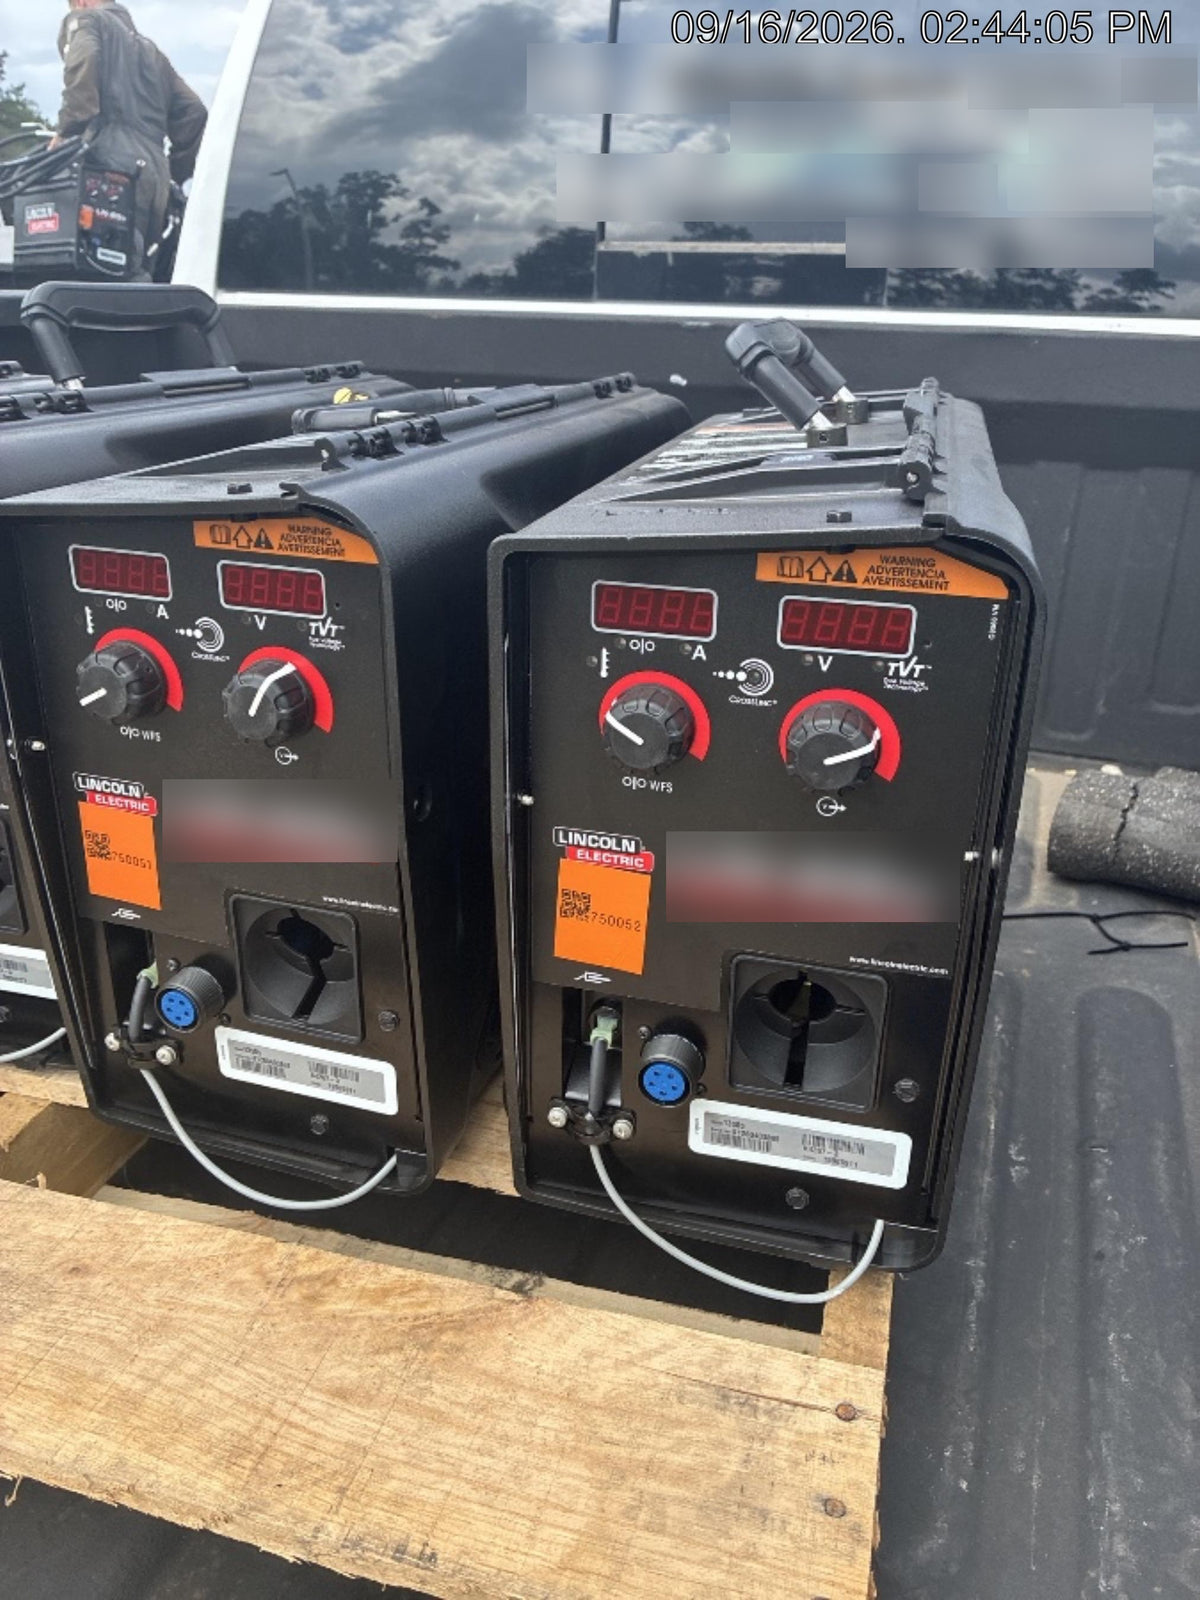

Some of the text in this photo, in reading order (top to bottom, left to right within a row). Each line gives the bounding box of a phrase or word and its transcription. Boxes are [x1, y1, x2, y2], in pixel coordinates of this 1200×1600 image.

[287, 524, 332, 536] WARNING
[880, 554, 936, 568] WARNING
[867, 565, 947, 580] ADVERTENCIA
[862, 575, 950, 591] AVERTISSEMENT
[156, 604, 169, 619] A
[254, 615, 267, 630] V
[691, 645, 707, 661] A
[818, 655, 833, 672] V
[77, 776, 141, 798] LINCOLN
[649, 779, 673, 793] WFS
[94, 794, 150, 812] ELECTRIC
[558, 829, 636, 853] LINCOLN
[576, 849, 645, 868] ELECTRIC
